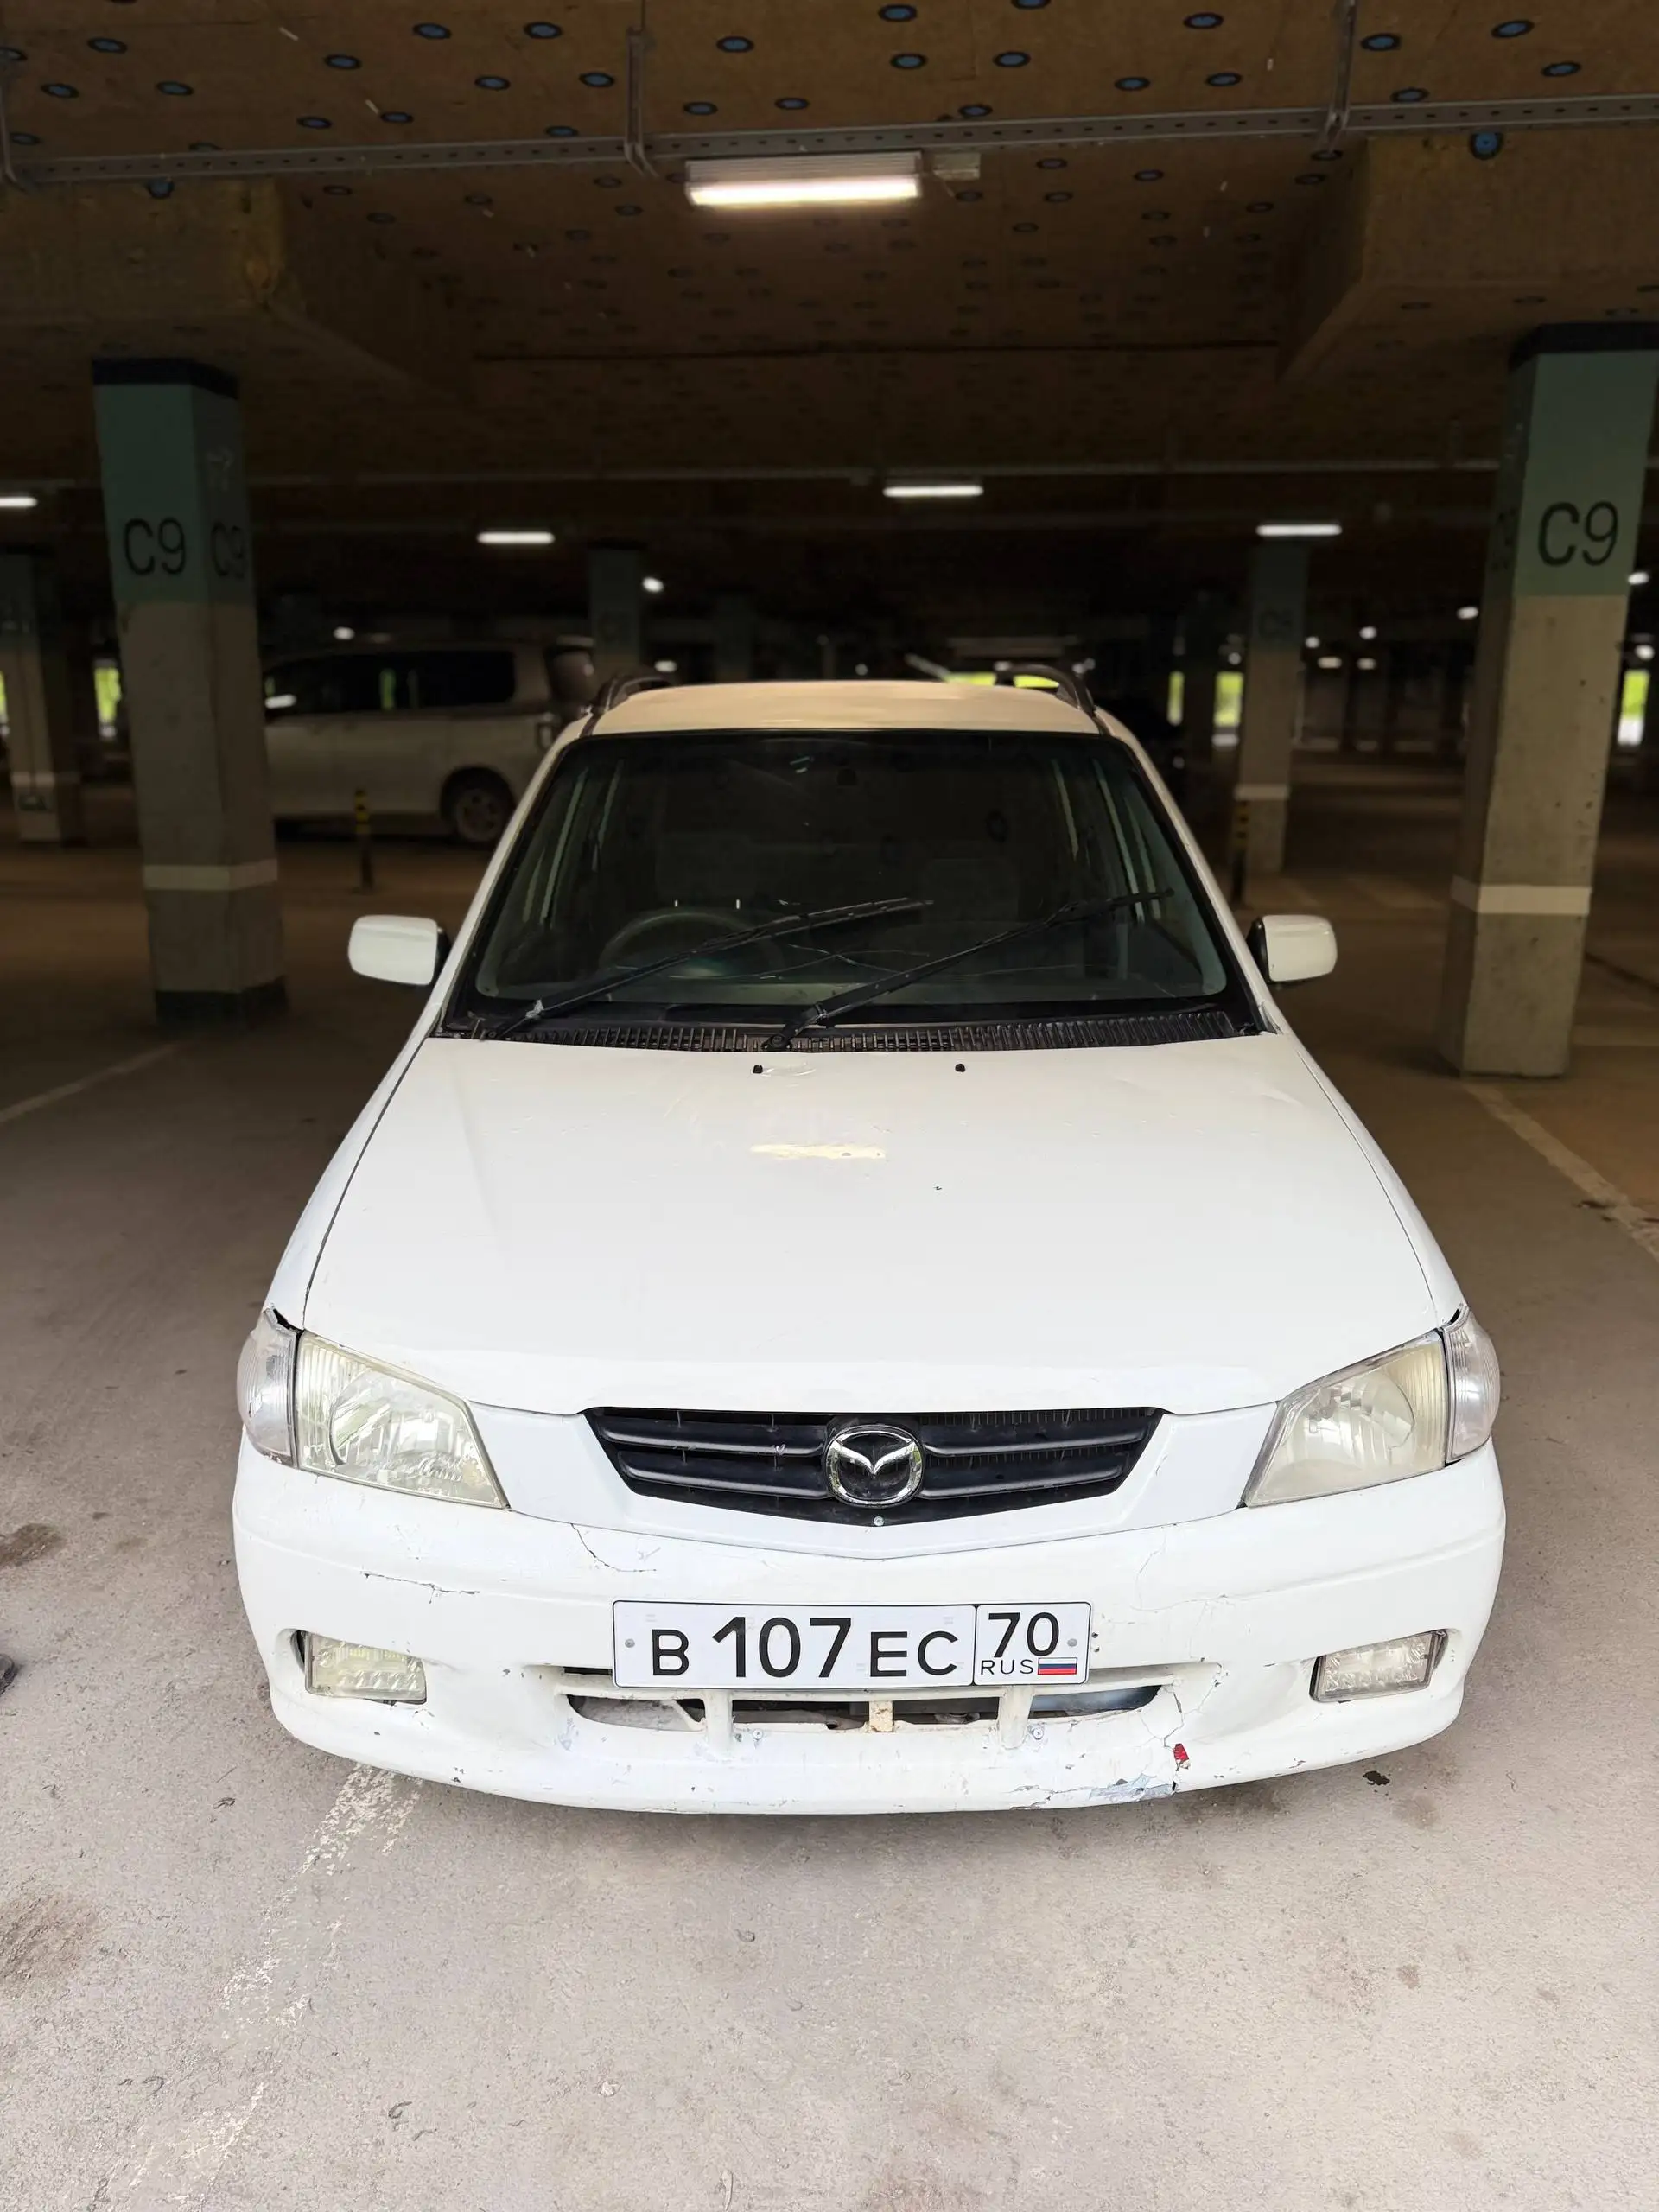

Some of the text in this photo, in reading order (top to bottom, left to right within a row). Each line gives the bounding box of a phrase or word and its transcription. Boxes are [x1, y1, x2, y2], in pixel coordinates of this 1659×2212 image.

[124, 518, 186, 575] C9
[1538, 501, 1618, 567] C9
[711, 1616, 852, 1678] 107
[988, 1611, 1059, 1658] 70
[980, 1658, 1034, 1675] RUS
